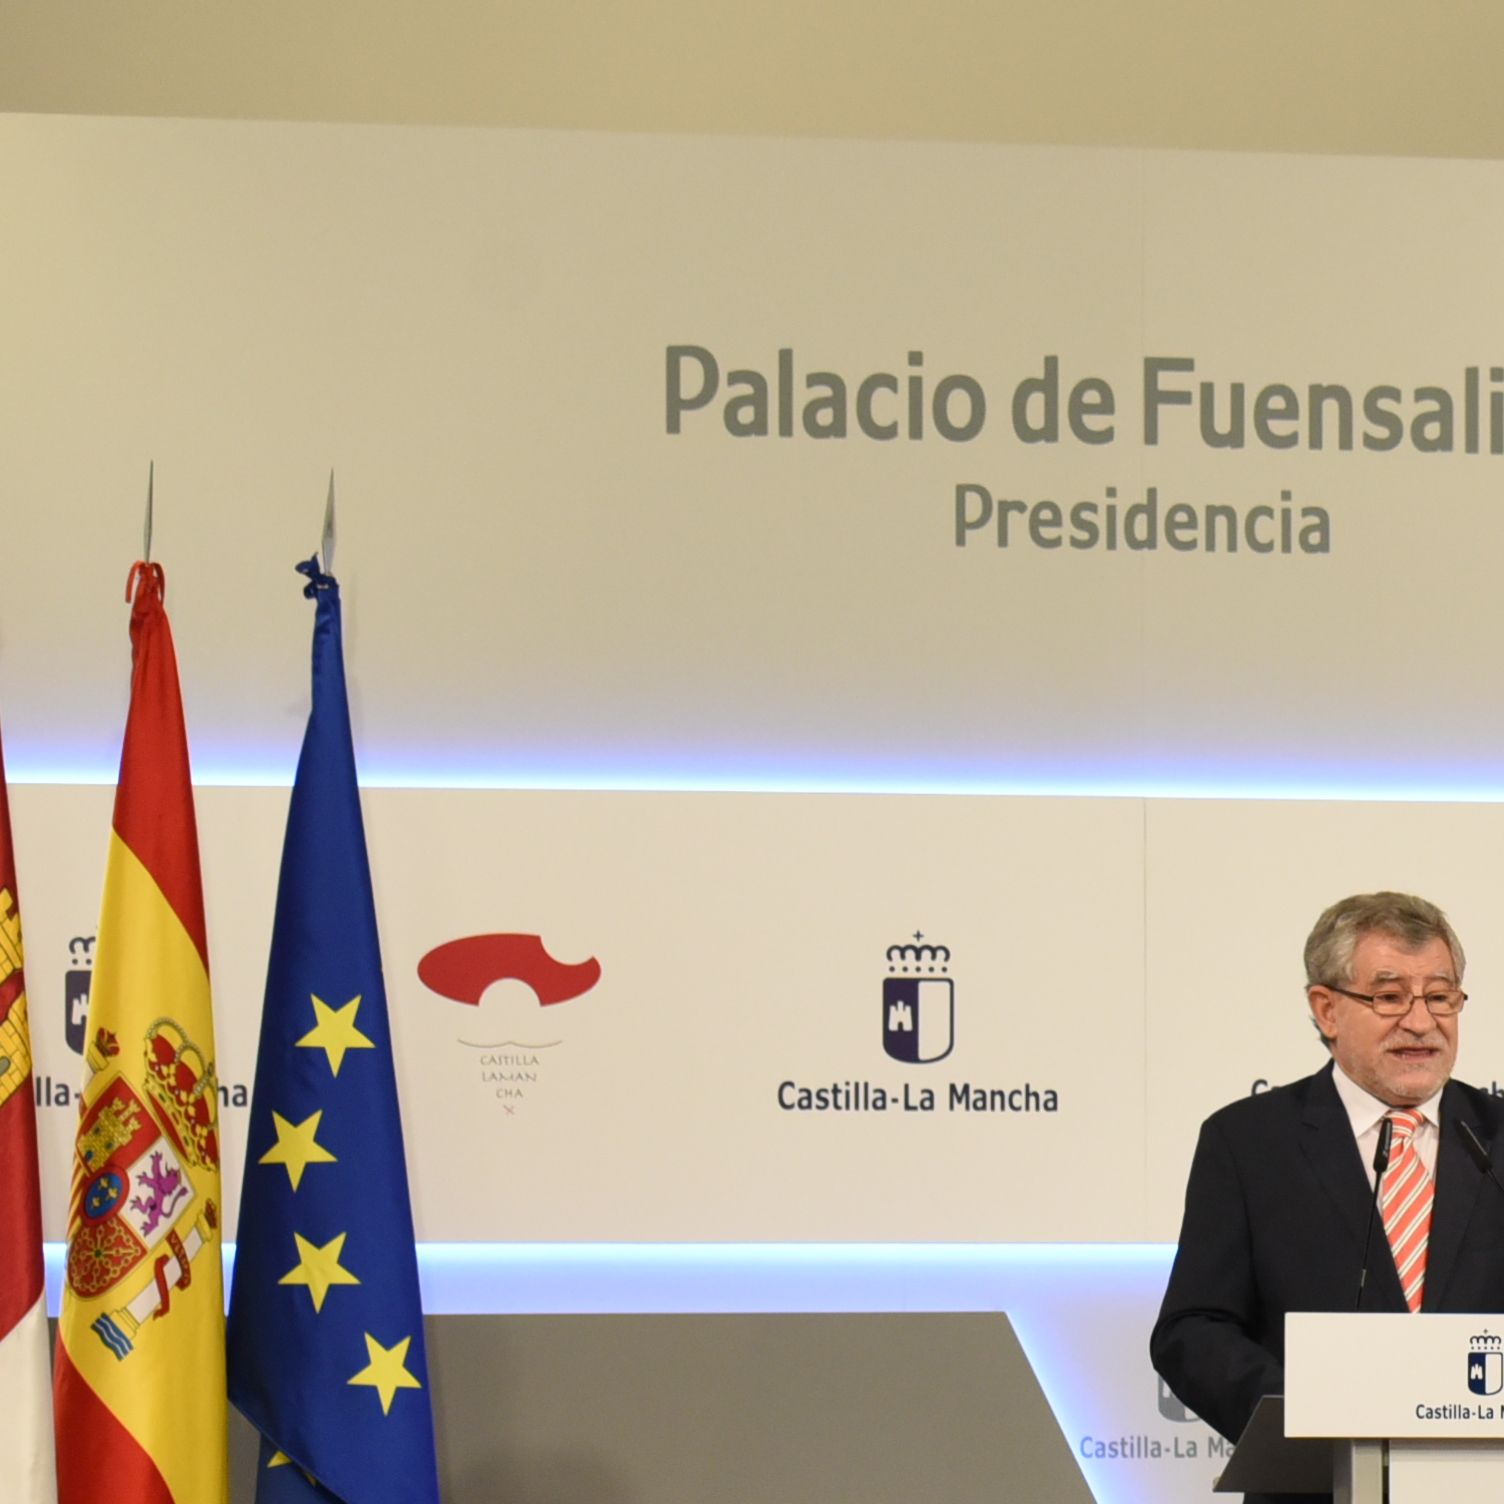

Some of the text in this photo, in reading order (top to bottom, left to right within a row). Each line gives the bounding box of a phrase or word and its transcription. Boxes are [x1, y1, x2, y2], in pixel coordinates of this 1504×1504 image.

[665, 345, 987, 443] Palacio
[1010, 355, 1116, 446] de
[955, 483, 1332, 555] Presidencia
[480, 1055, 540, 1066] CASTILLA
[777, 1081, 1059, 1113] Castilla-La Mancha
[1415, 1404, 1494, 1420] Castilla-La
[1080, 1436, 1198, 1459] Castilla-La
